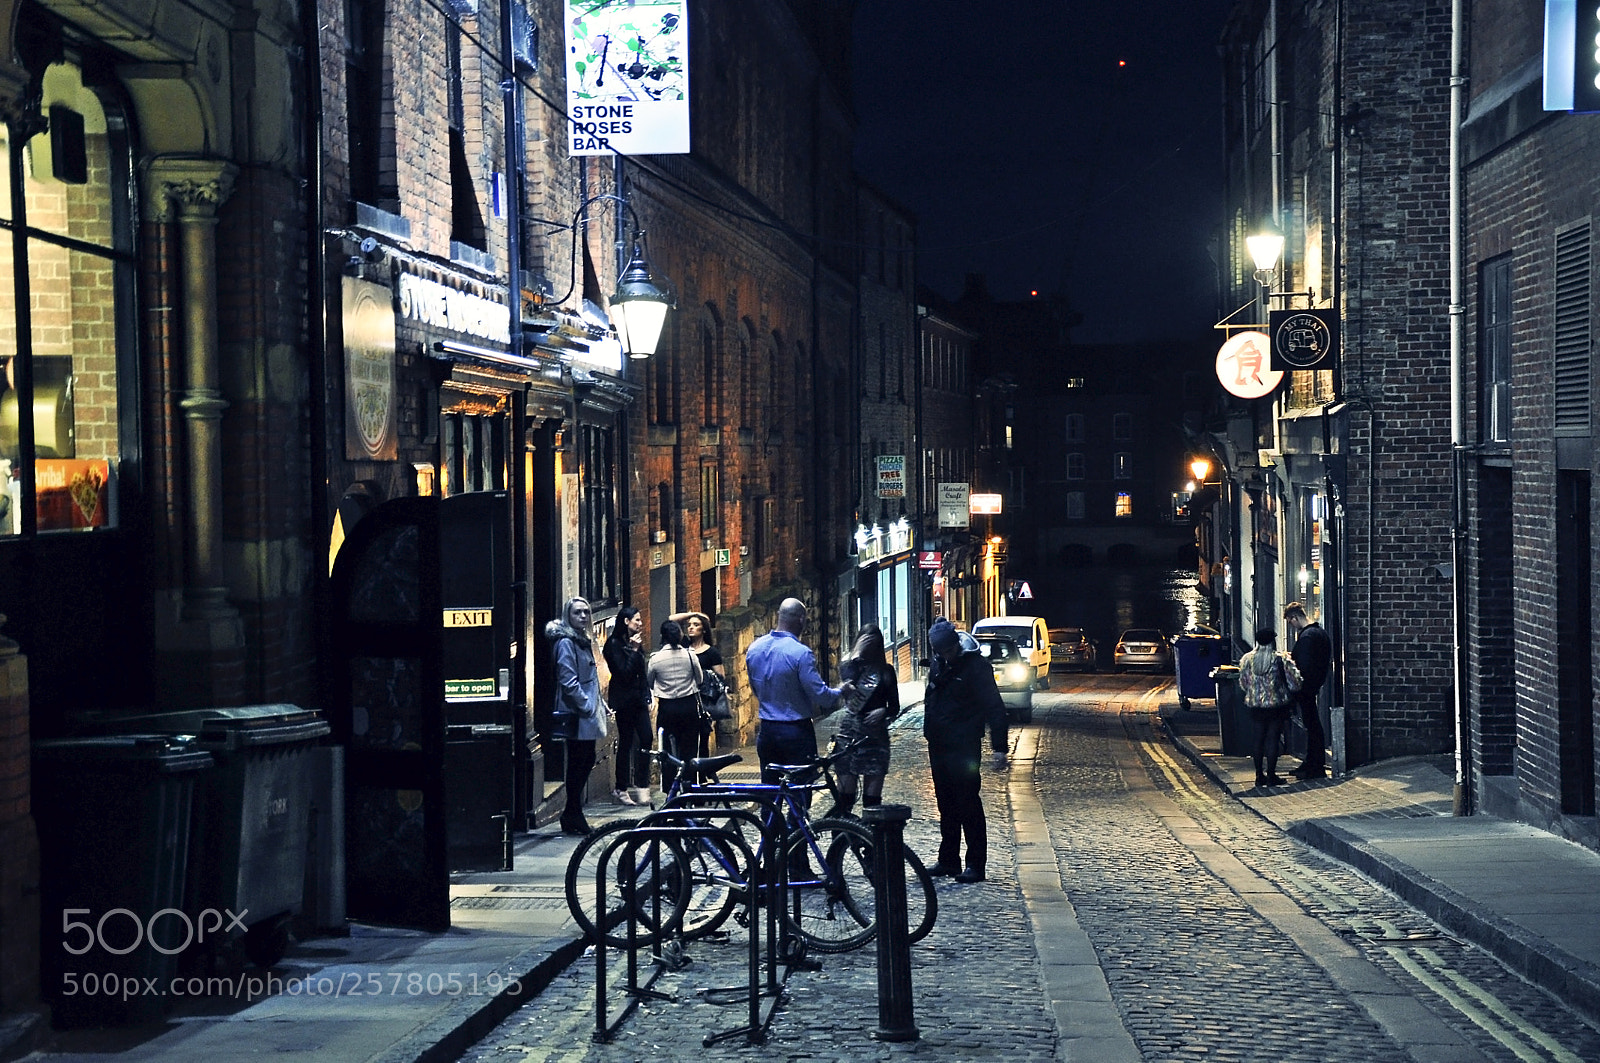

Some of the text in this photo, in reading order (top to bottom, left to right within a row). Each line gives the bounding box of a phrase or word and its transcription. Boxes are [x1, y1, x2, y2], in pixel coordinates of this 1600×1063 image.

[573, 105, 633, 118] STONE
[573, 121, 632, 135] ROSES
[573, 138, 610, 150] BAR
[400, 272, 448, 328] STONE
[1284, 319, 1322, 332] MY THAI
[879, 456, 903, 465] PIZZAS
[880, 471, 900, 479] FREE
[945, 492, 962, 500] Craft
[452, 612, 489, 625] EXIT
[472, 685, 492, 693] open
